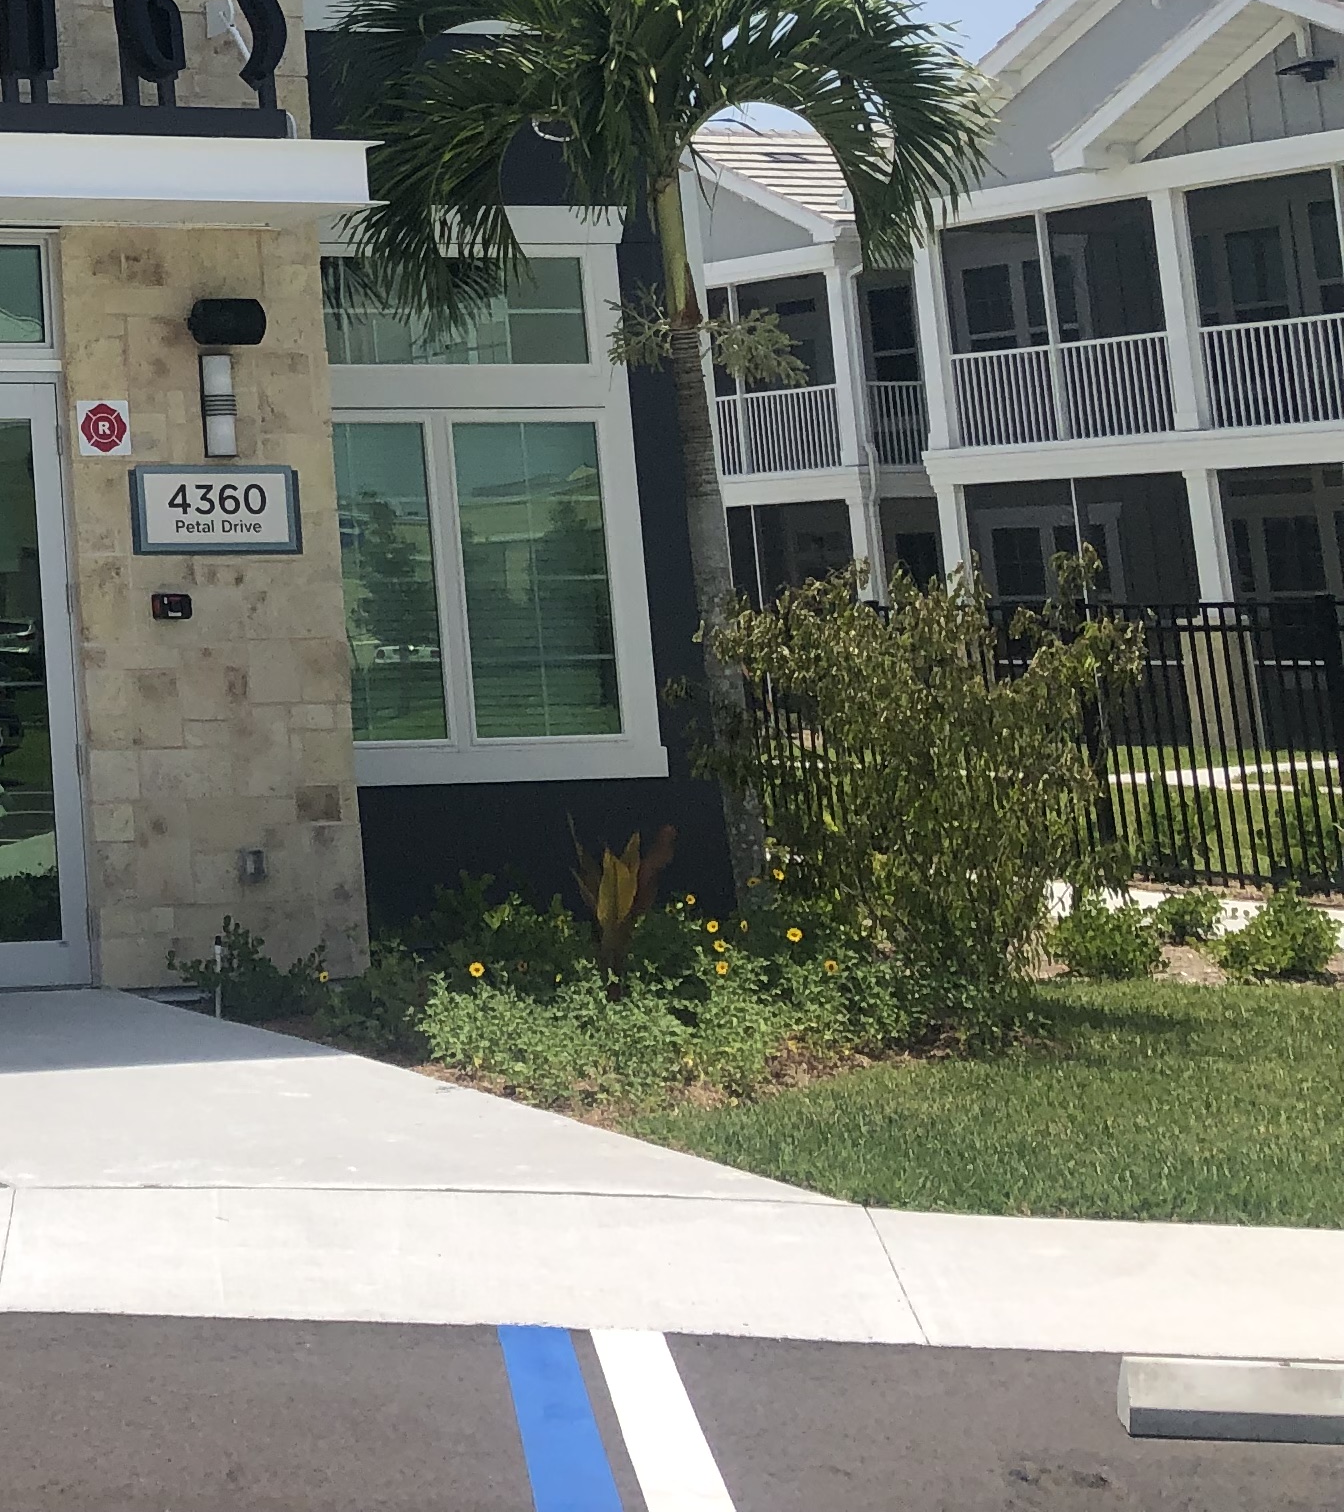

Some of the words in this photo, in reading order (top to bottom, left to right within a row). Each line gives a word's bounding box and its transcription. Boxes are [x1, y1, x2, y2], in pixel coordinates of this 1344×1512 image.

[98, 421, 111, 435] R
[167, 483, 268, 516] 4360
[175, 519, 215, 534] Petal
[221, 519, 263, 534] Drive
